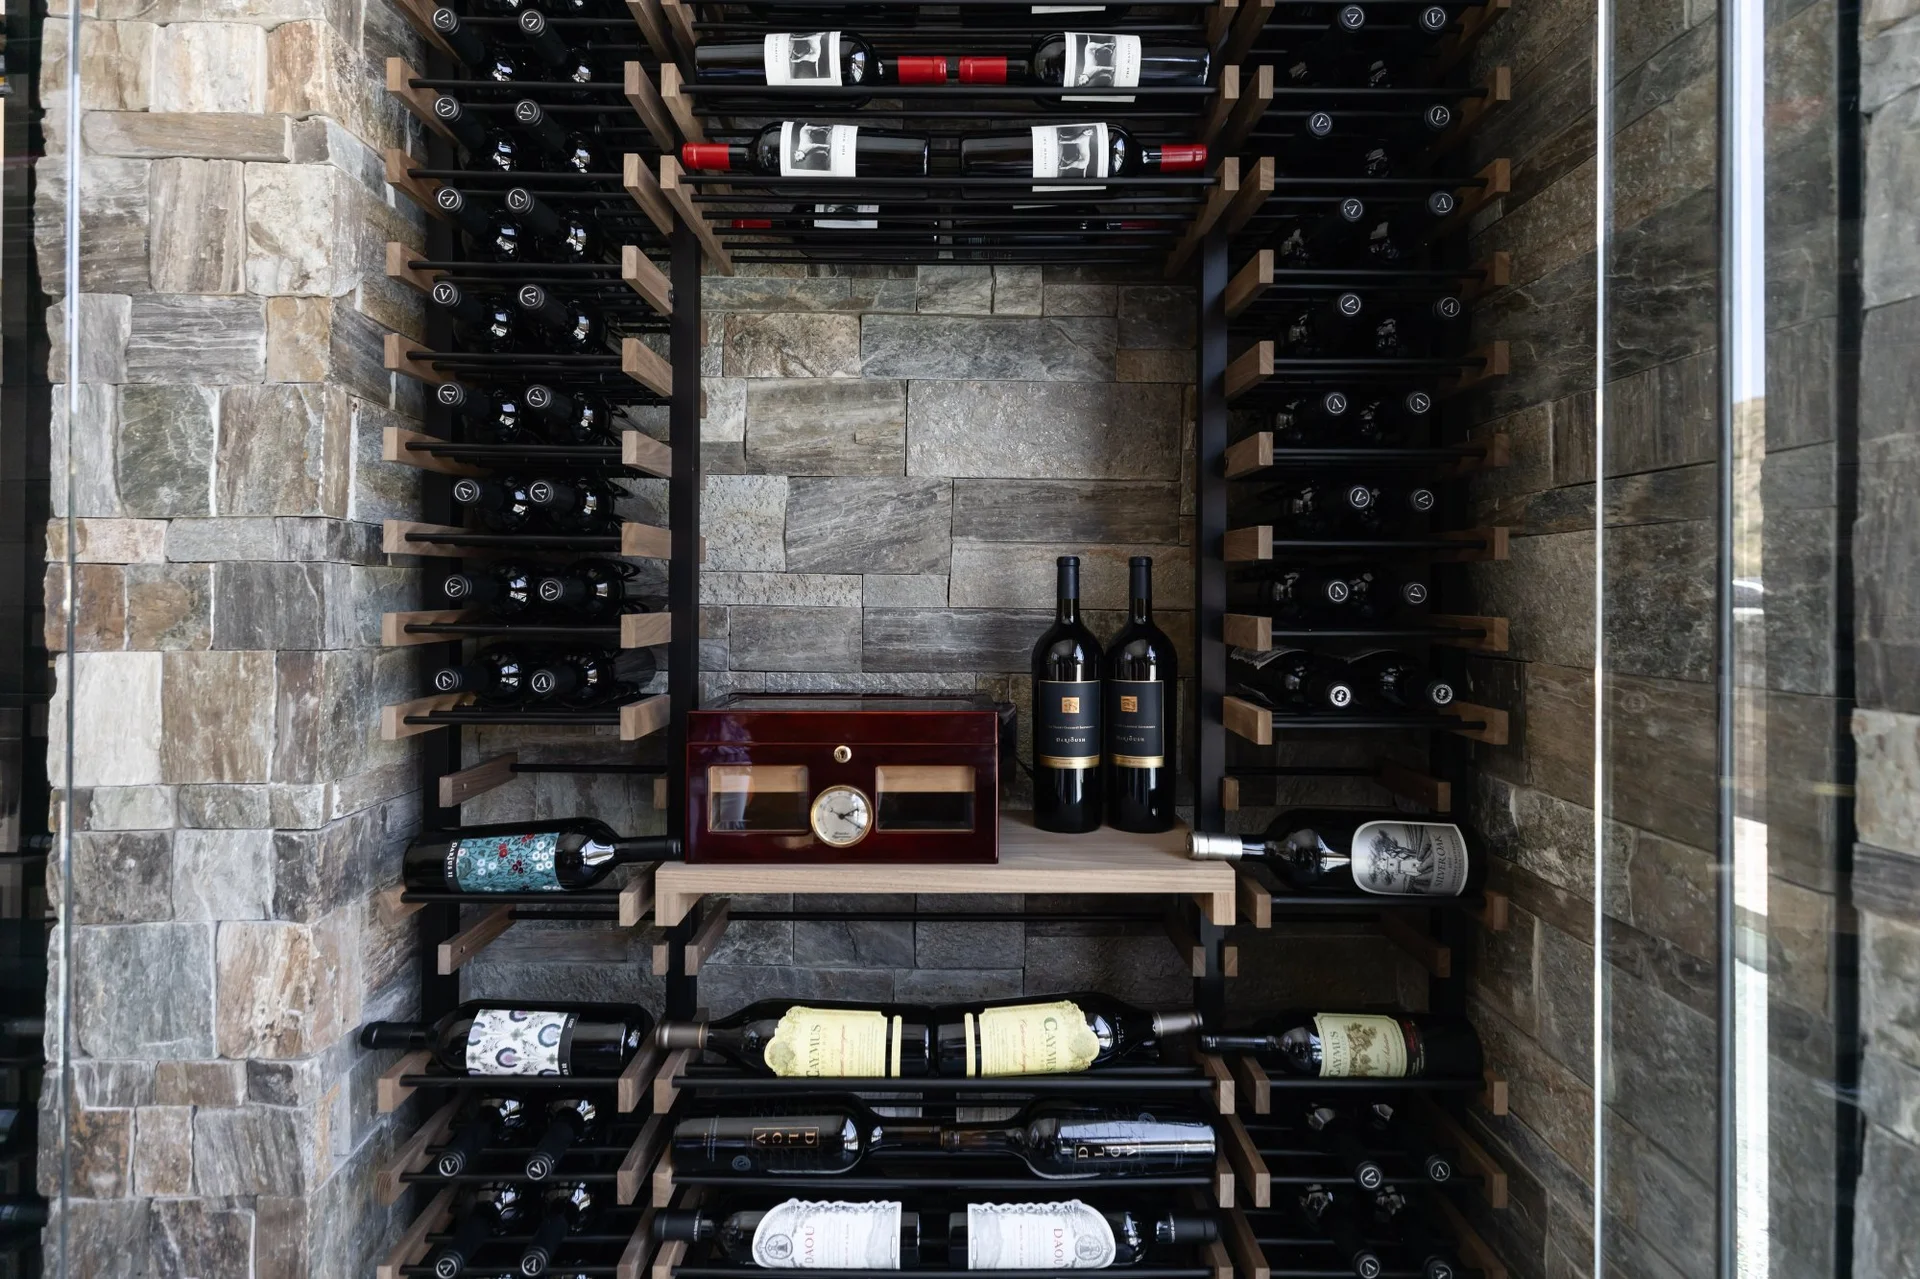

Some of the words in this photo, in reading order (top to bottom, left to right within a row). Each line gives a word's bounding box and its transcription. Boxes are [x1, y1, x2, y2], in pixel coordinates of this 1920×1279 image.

[1433, 834, 1446, 857] OAK
[1434, 856, 1446, 888] SILVER
[806, 1024, 821, 1078] CAYMUS
[1043, 1017, 1058, 1073] CAYMUS
[1327, 1031, 1341, 1077] CAYMUS
[756, 1131, 816, 1145] DLCV
[804, 1225, 815, 1264] DAOU
[1053, 1228, 1064, 1267] DAOU
